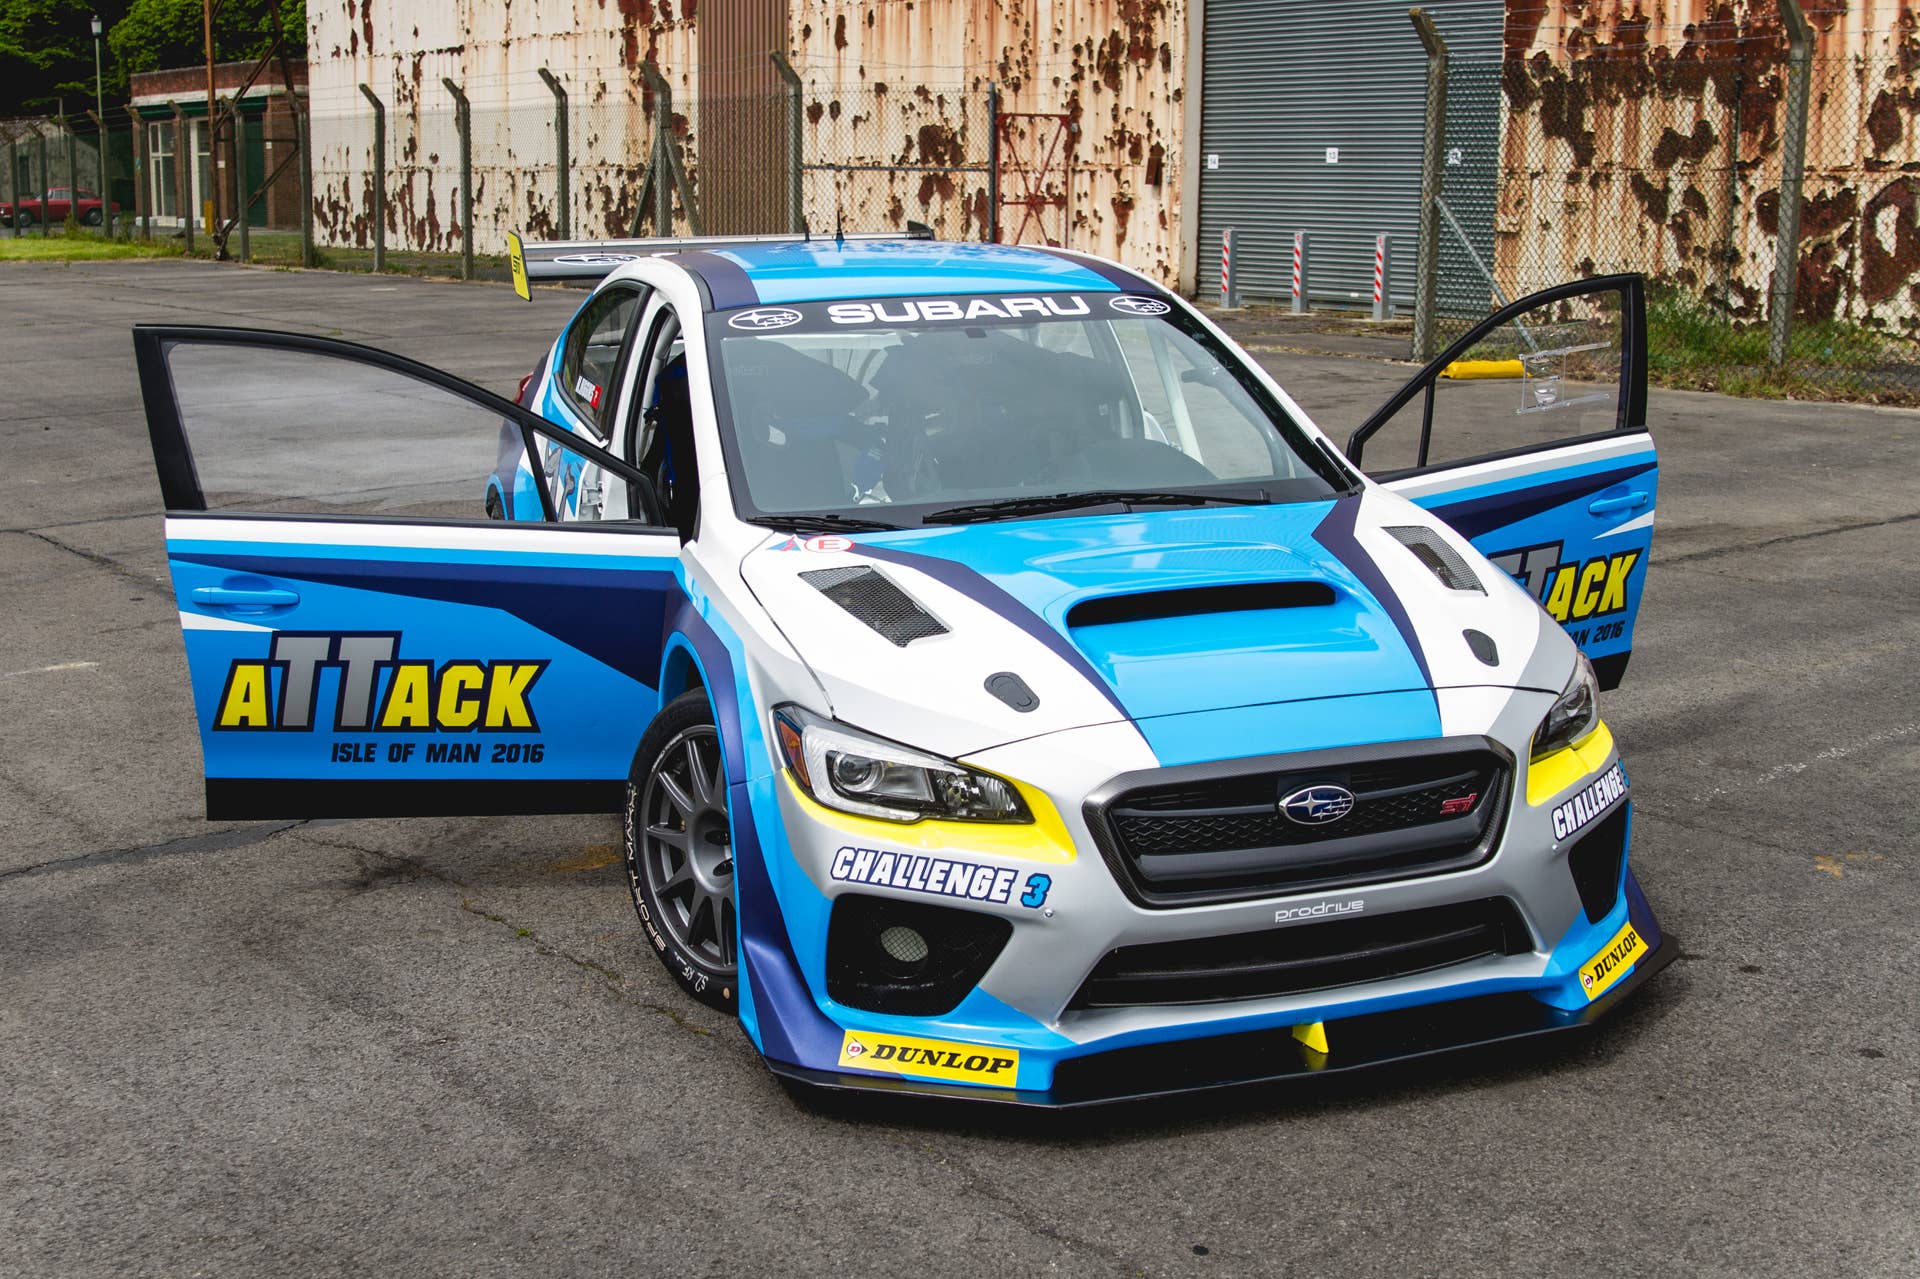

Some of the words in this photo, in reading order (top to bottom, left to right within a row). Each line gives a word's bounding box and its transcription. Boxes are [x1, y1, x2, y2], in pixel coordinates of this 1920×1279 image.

[827, 295, 1091, 324] SUBARU
[1567, 628, 1591, 648] AN
[1592, 621, 1626, 644] 2016
[212, 630, 552, 732] ATTACK
[331, 743, 377, 763] ISLE
[387, 743, 416, 763] OF
[425, 743, 482, 763] MAN
[491, 743, 546, 763] 2016
[1551, 763, 1626, 842] CHALLENGE
[830, 846, 1019, 904] CHALLENGE
[1020, 873, 1052, 908] 3
[630, 869, 667, 952] SPORT
[1275, 900, 1364, 923] prodrive
[1593, 931, 1638, 982] DUNLOP
[870, 1043, 1014, 1074] DUNLOP
